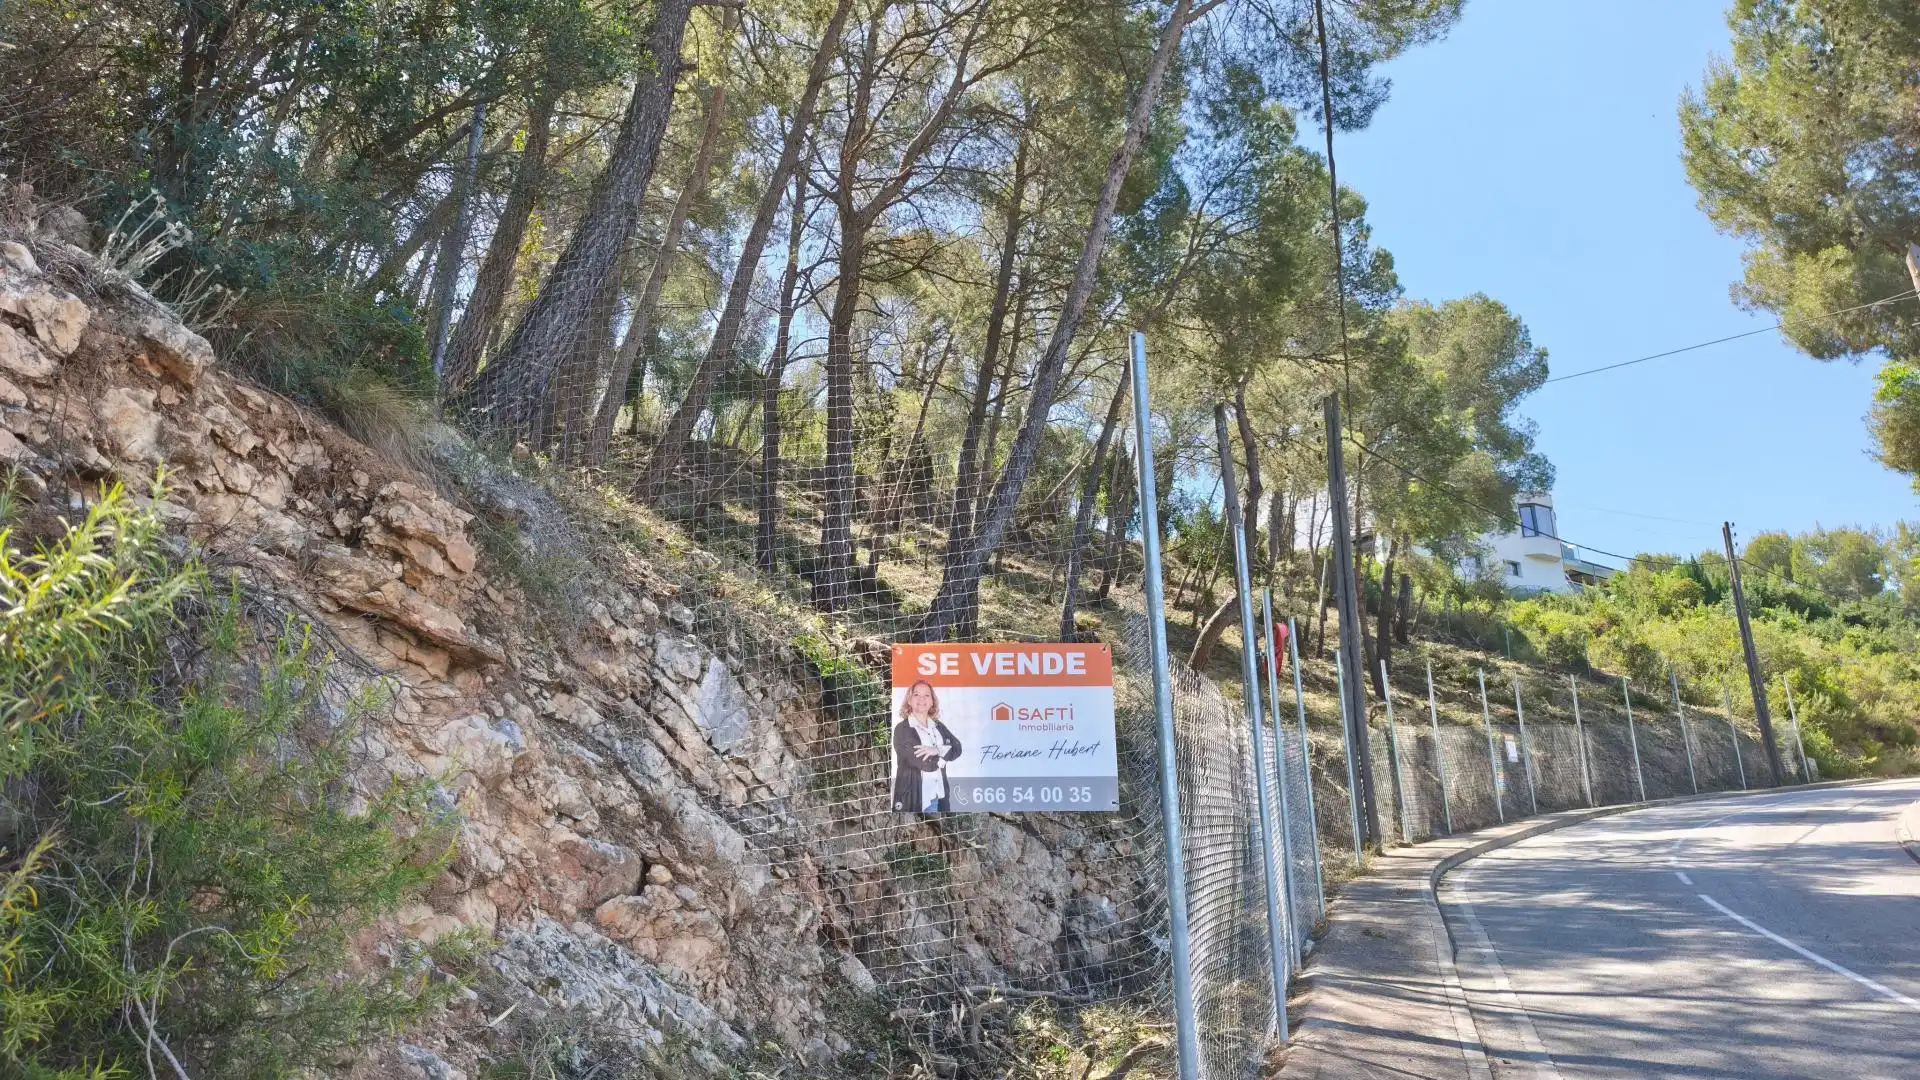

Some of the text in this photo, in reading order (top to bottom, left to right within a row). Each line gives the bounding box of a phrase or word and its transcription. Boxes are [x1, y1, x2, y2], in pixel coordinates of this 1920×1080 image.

[917, 652, 1087, 676] SE VENDE
[1018, 722, 1075, 731] Inmobiliaria
[979, 739, 1101, 765] Floriane Hubert
[972, 786, 1092, 804] 666 54 00 35
